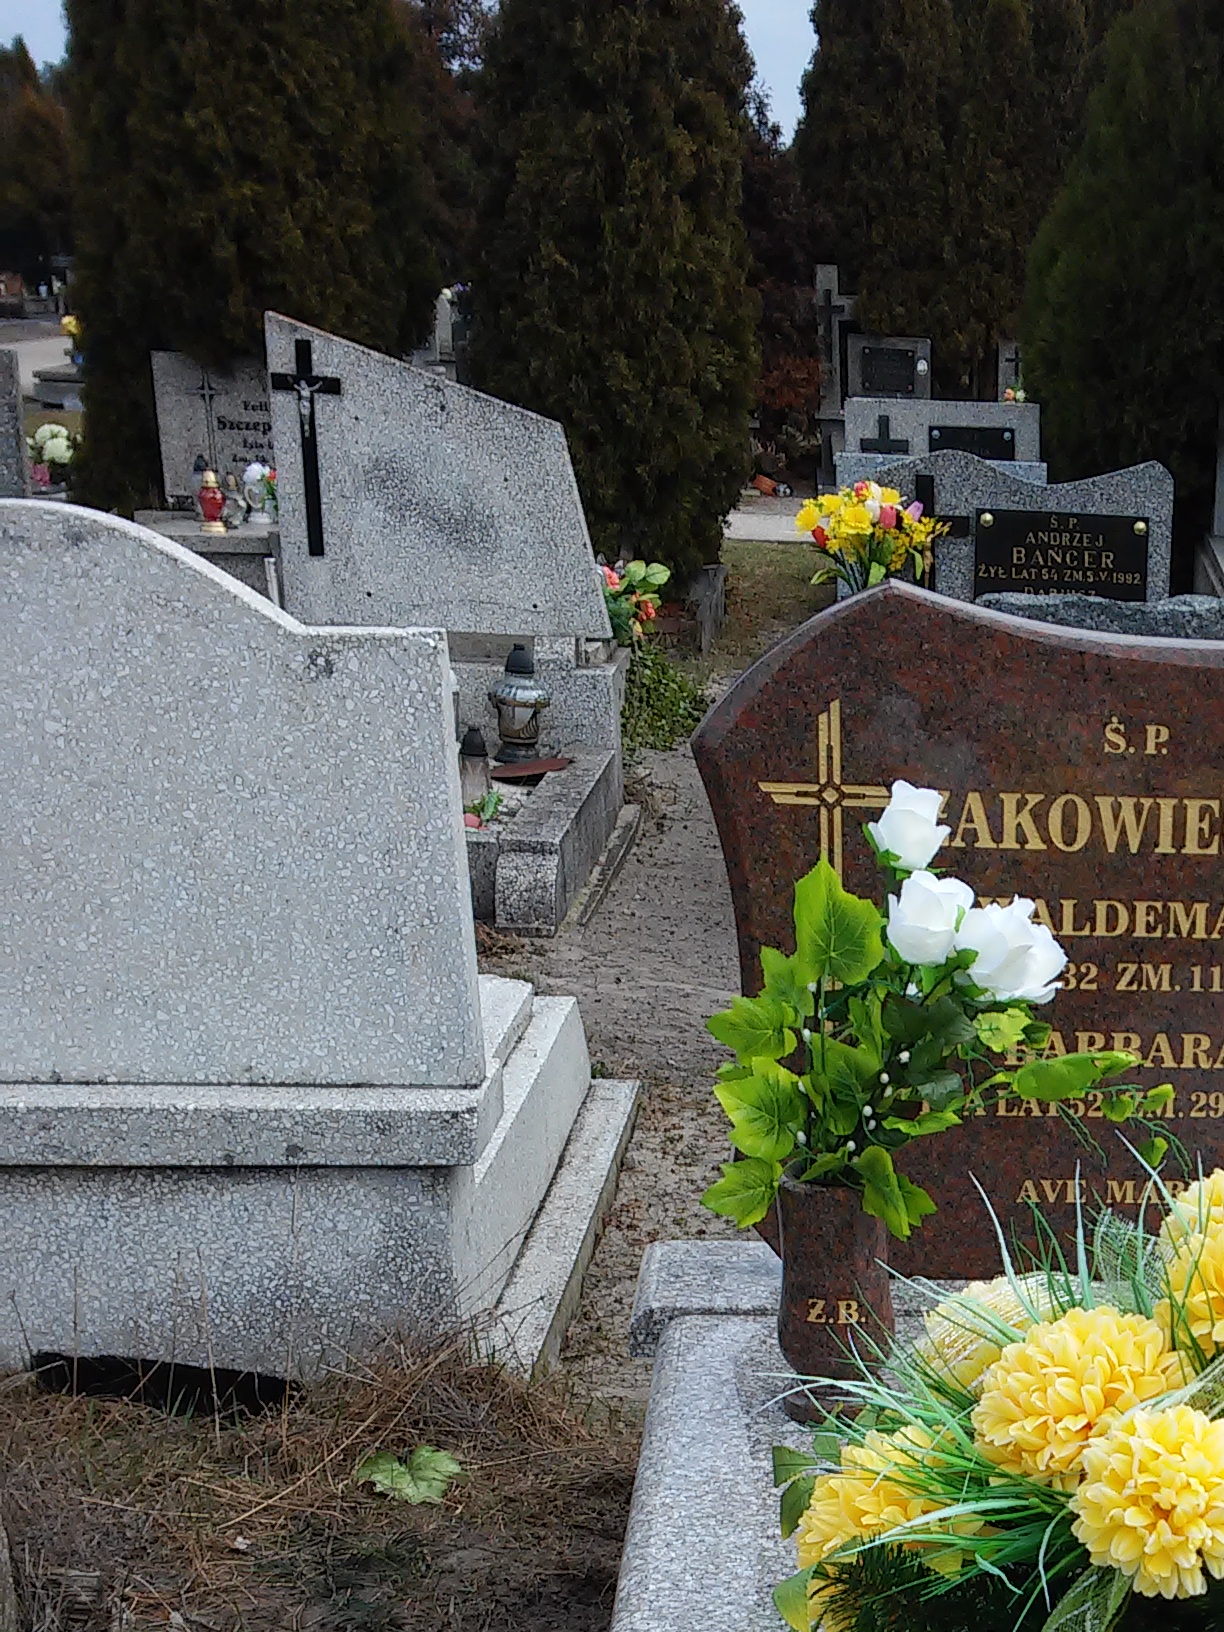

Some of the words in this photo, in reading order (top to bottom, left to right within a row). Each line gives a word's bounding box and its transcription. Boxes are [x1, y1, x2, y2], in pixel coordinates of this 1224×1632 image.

[1025, 531, 1104, 548] ANDRZEJ
[1011, 567, 1039, 580] LAT
[1041, 569, 1058, 581] 54
[1144, 723, 1168, 755] P.
[1115, 961, 1181, 993] ZM.
[1016, 1178, 1087, 1204] AVE
